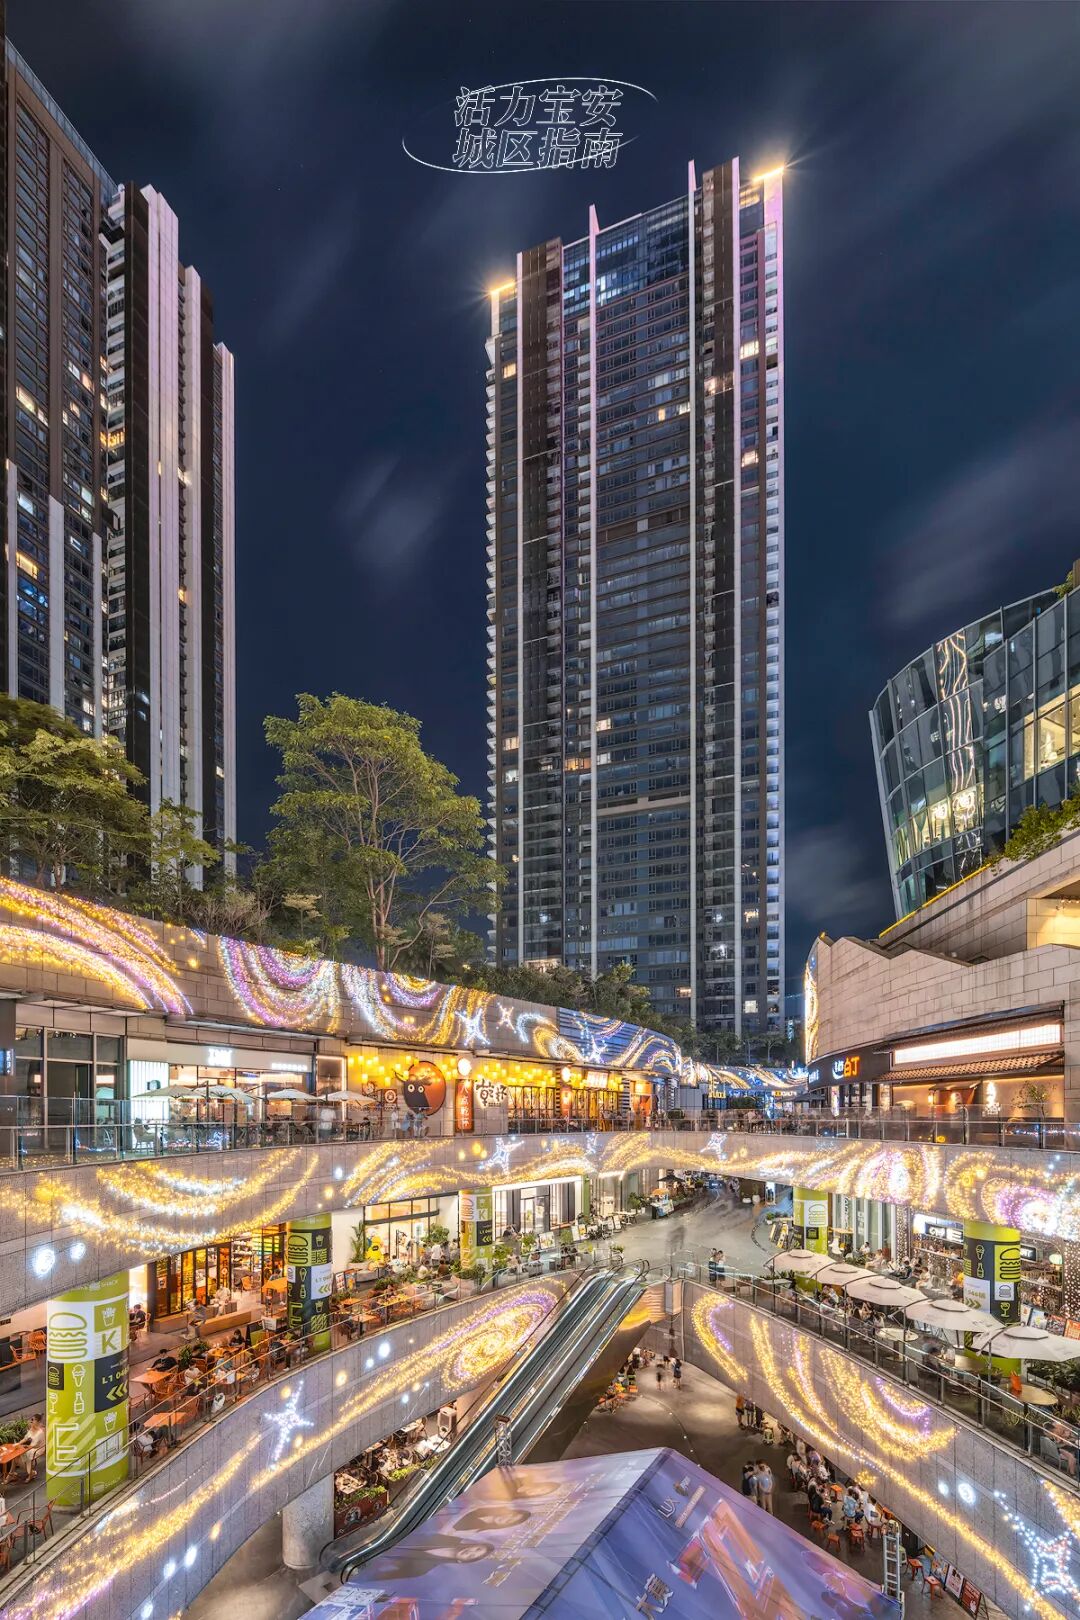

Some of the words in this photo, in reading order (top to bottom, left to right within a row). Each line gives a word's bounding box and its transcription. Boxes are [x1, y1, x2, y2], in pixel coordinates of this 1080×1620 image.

[101, 1330, 117, 1354] K
[53, 1423, 80, 1466] E
[658, 1497, 680, 1518] LUX
